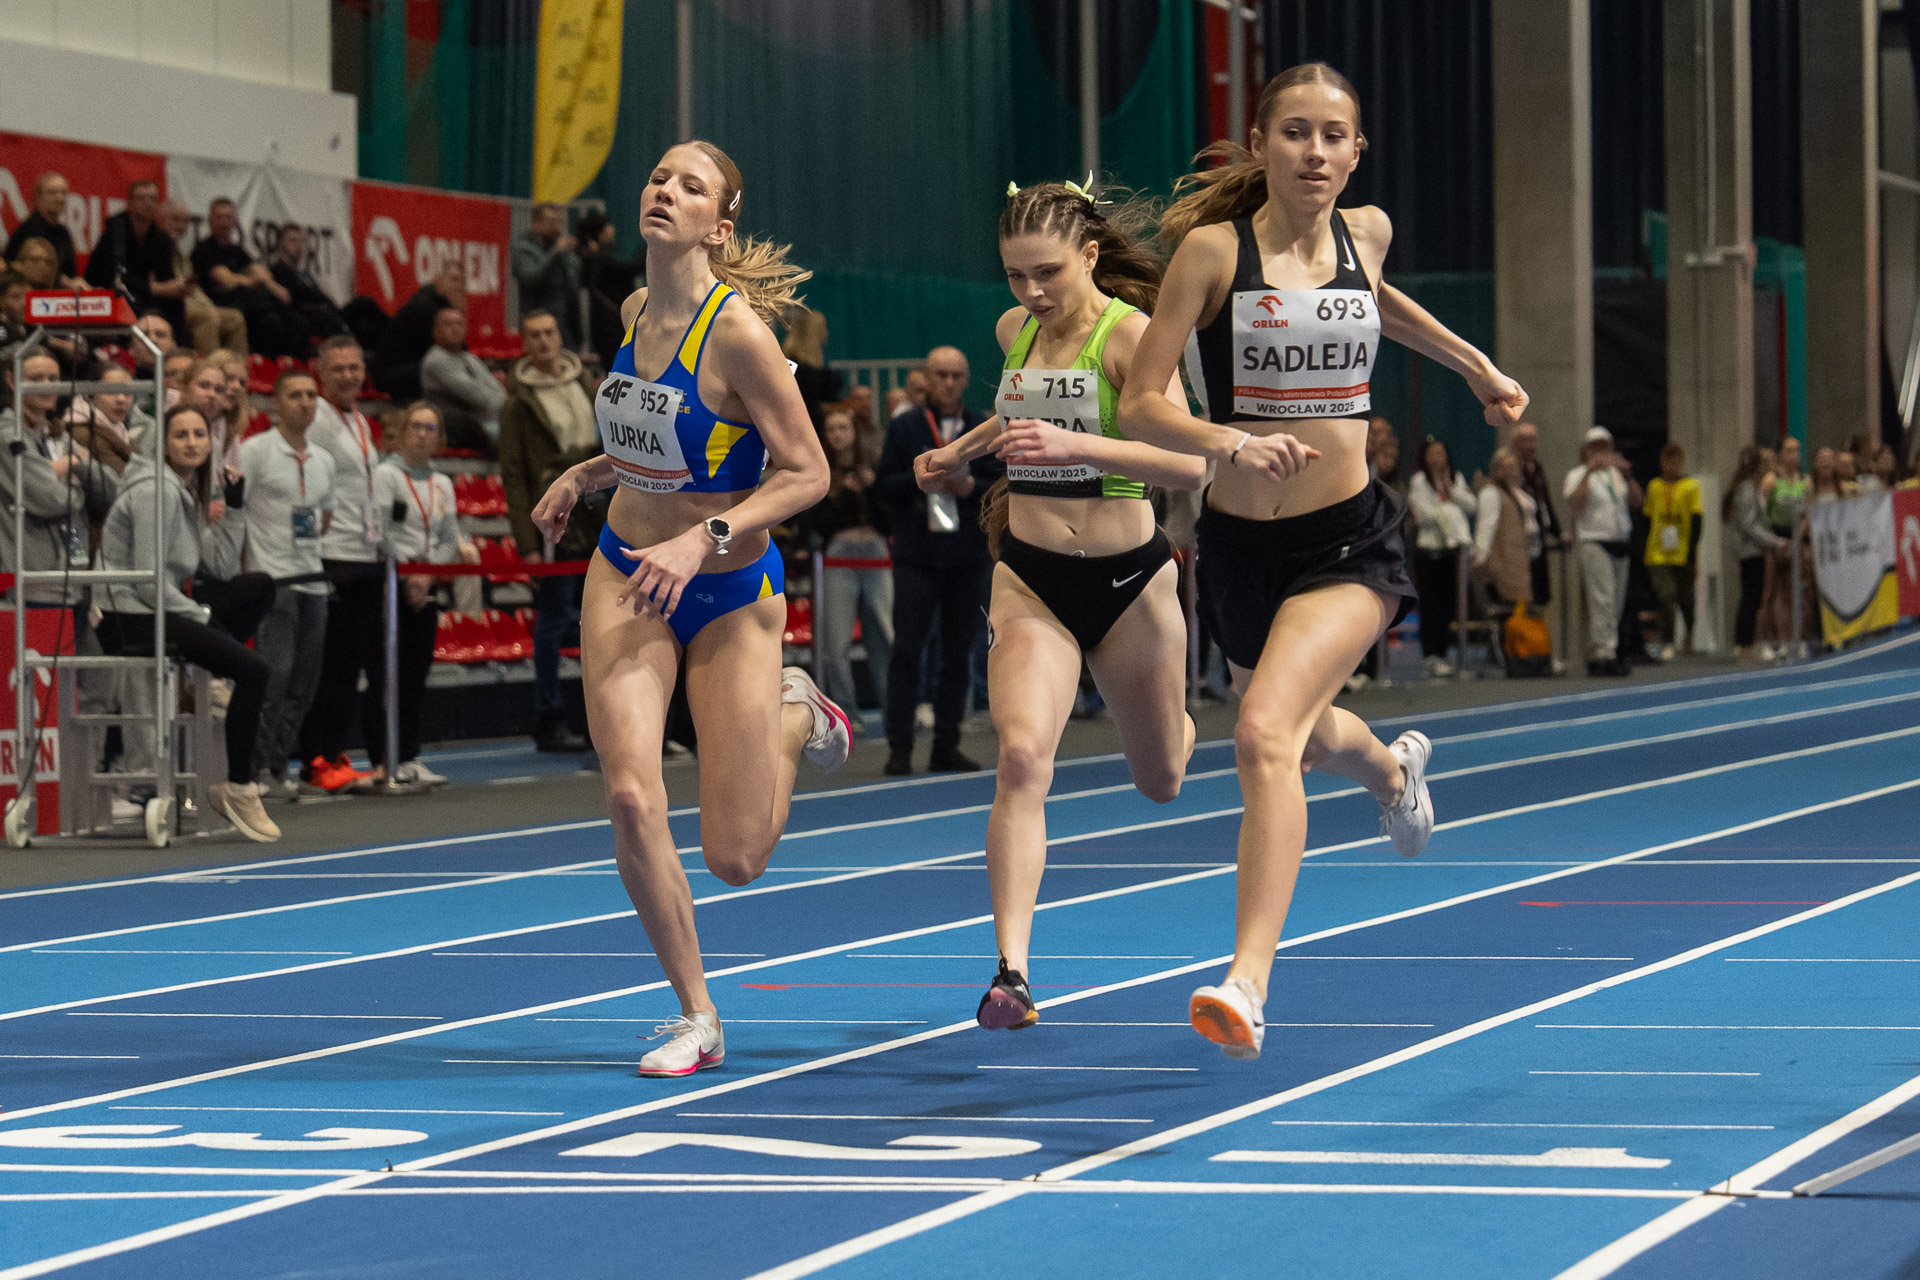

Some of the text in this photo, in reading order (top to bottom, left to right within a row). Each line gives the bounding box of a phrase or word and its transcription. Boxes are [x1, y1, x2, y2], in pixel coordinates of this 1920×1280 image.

[1252, 297, 1367, 329] ORLEN 693
[1243, 342, 1367, 372] SADLEJA
[640, 389, 669, 415] 952
[1004, 377, 1085, 402] ORLEN 715
[1256, 400, 1355, 415] WROCŁAW 2025
[609, 421, 665, 456] JURKA
[615, 469, 675, 491] WROCŁAW 2025
[1008, 467, 1087, 479] WROCŁAW 2025
[0, 1124, 430, 1152] 3
[557, 1131, 1043, 1162] 2
[1208, 1146, 1672, 1169] 1
